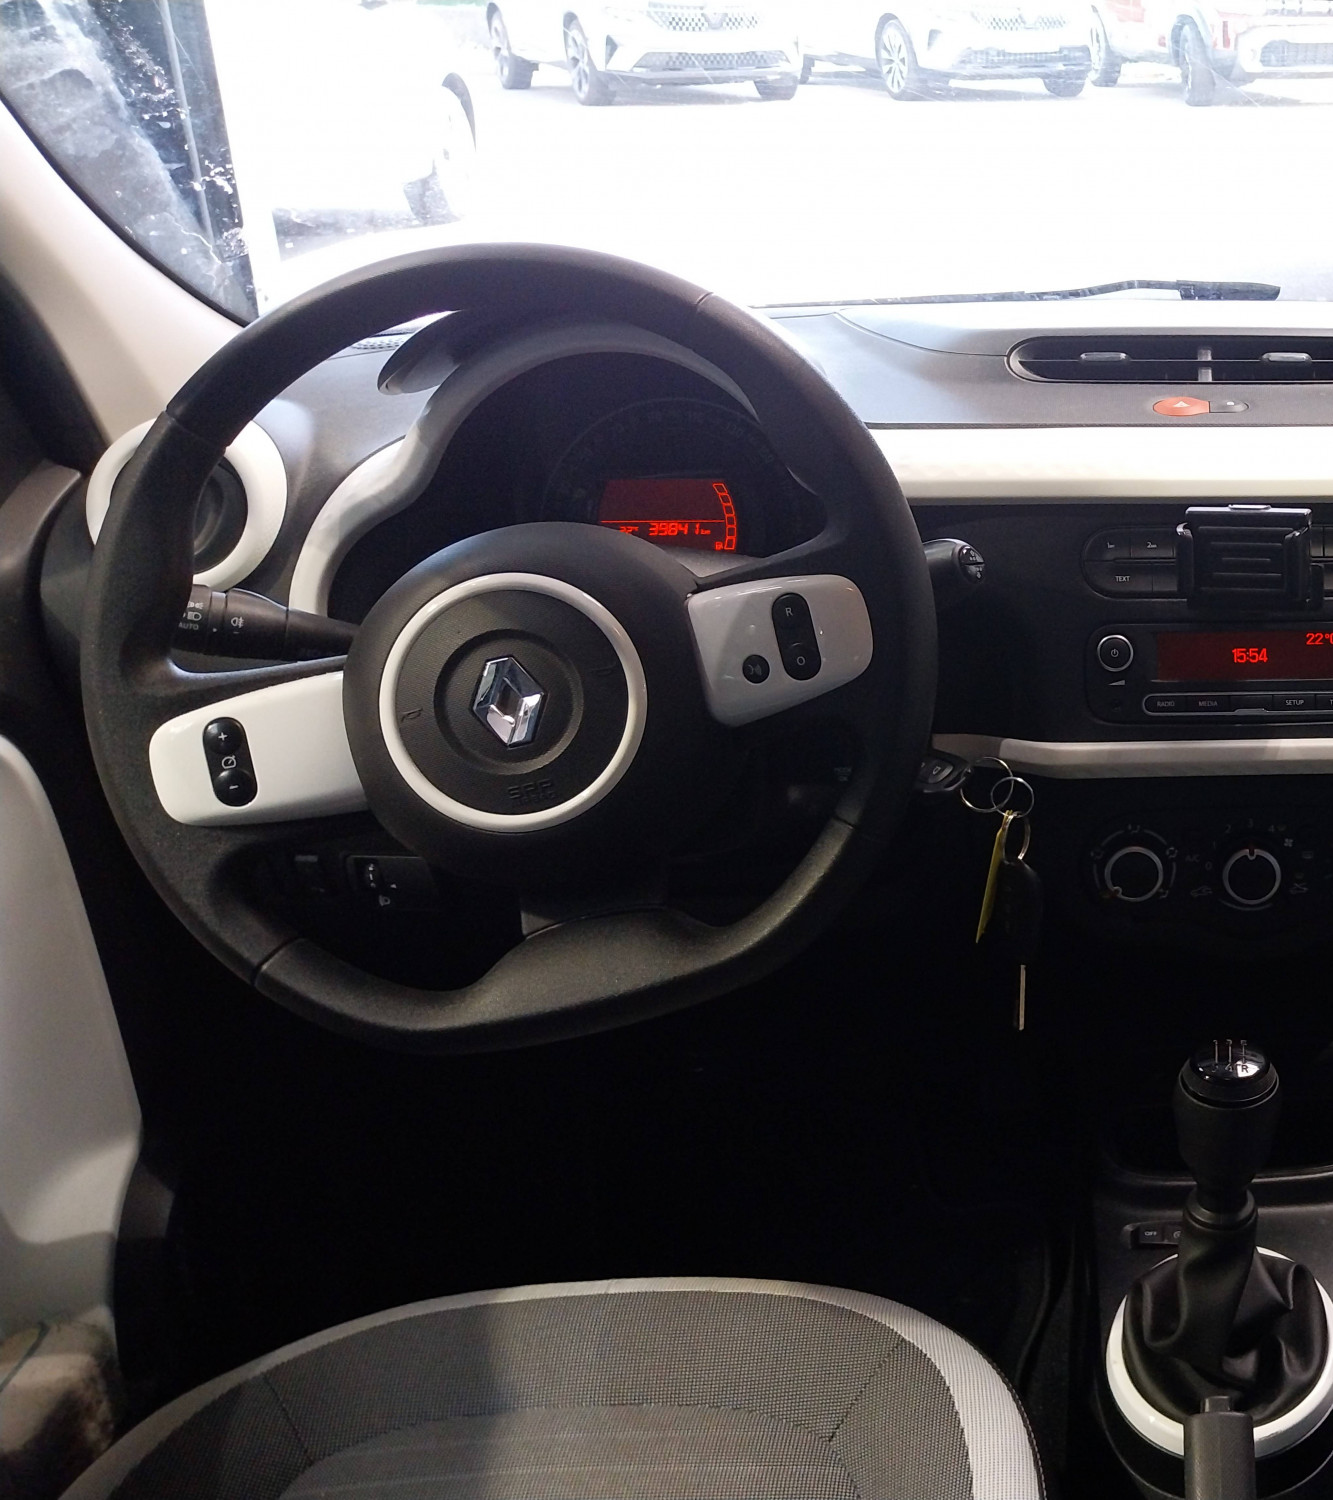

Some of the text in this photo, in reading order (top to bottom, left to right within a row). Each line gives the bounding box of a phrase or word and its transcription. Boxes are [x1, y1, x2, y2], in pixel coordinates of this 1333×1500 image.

[648, 522, 700, 536] 39841
[1115, 574, 1131, 582] TEXT
[785, 606, 794, 617] R
[178, 621, 200, 631] AUTO
[1231, 647, 1268, 663] 15:54
[1156, 700, 1175, 708] RADIO
[1198, 699, 1218, 708] MEDIA
[1285, 698, 1305, 707] SETUP
[1241, 1064, 1249, 1073] R
